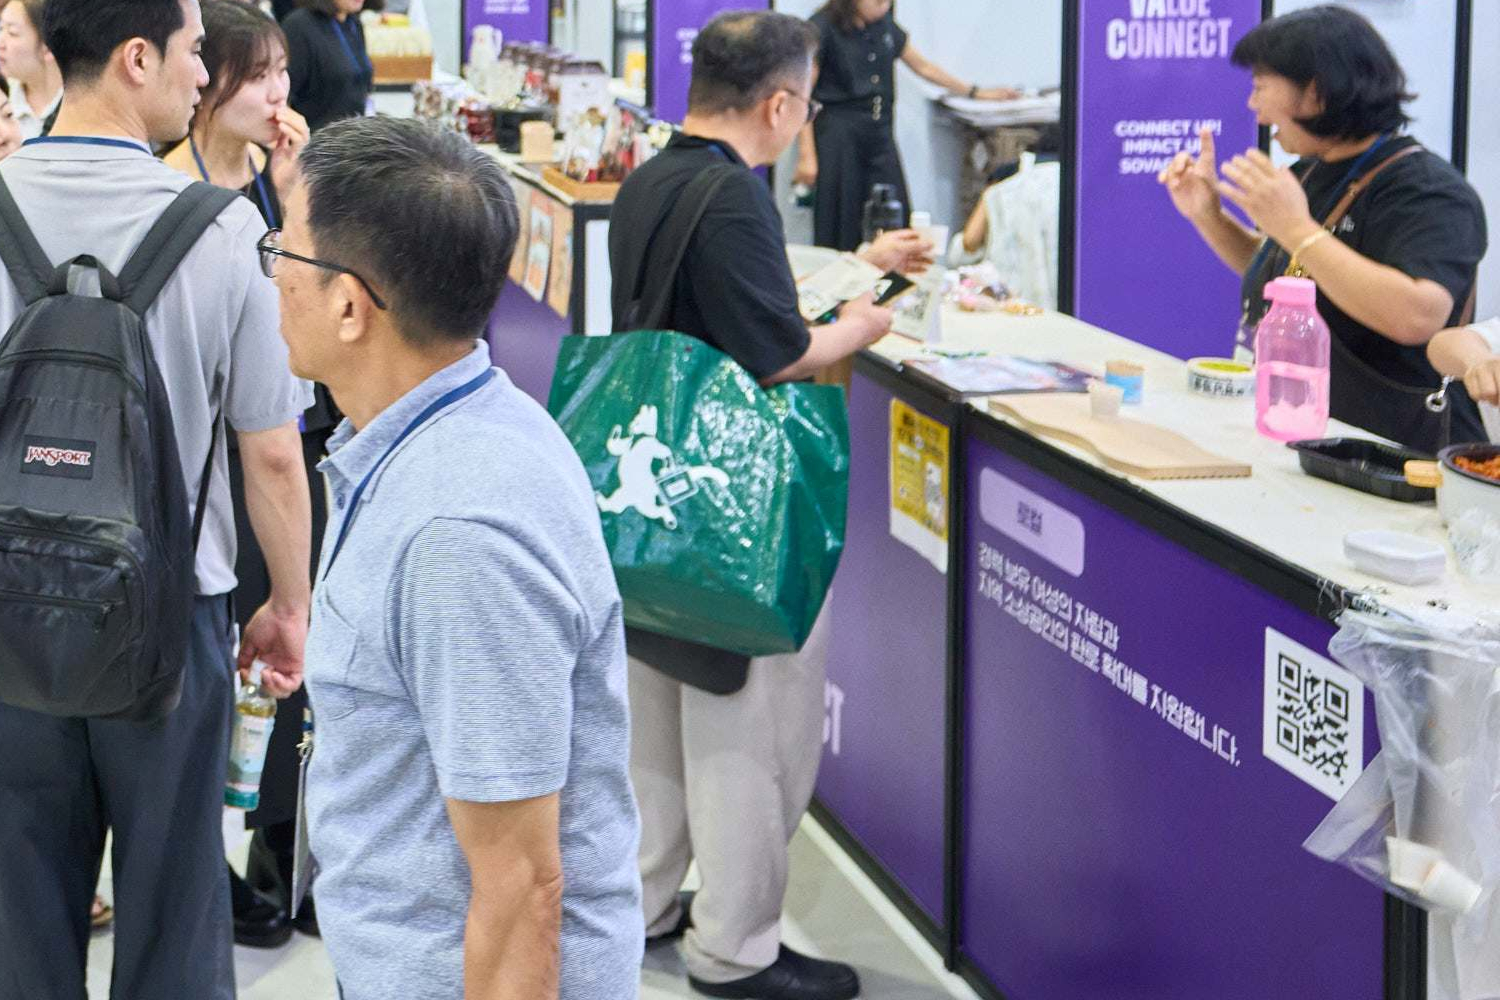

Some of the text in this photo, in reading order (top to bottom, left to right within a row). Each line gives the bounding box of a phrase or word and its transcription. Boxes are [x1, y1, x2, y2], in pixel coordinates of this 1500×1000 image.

[1106, 18, 1233, 60] CONNECT
[1113, 119, 1191, 137] CONNECT
[1122, 138, 1183, 155] IMPACT
[24, 446, 92, 467] JANSPORT
[1031, 574, 1073, 623] 여성의
[977, 570, 1241, 767] 지역 소상공인의 판로 확대를 지원합니다.
